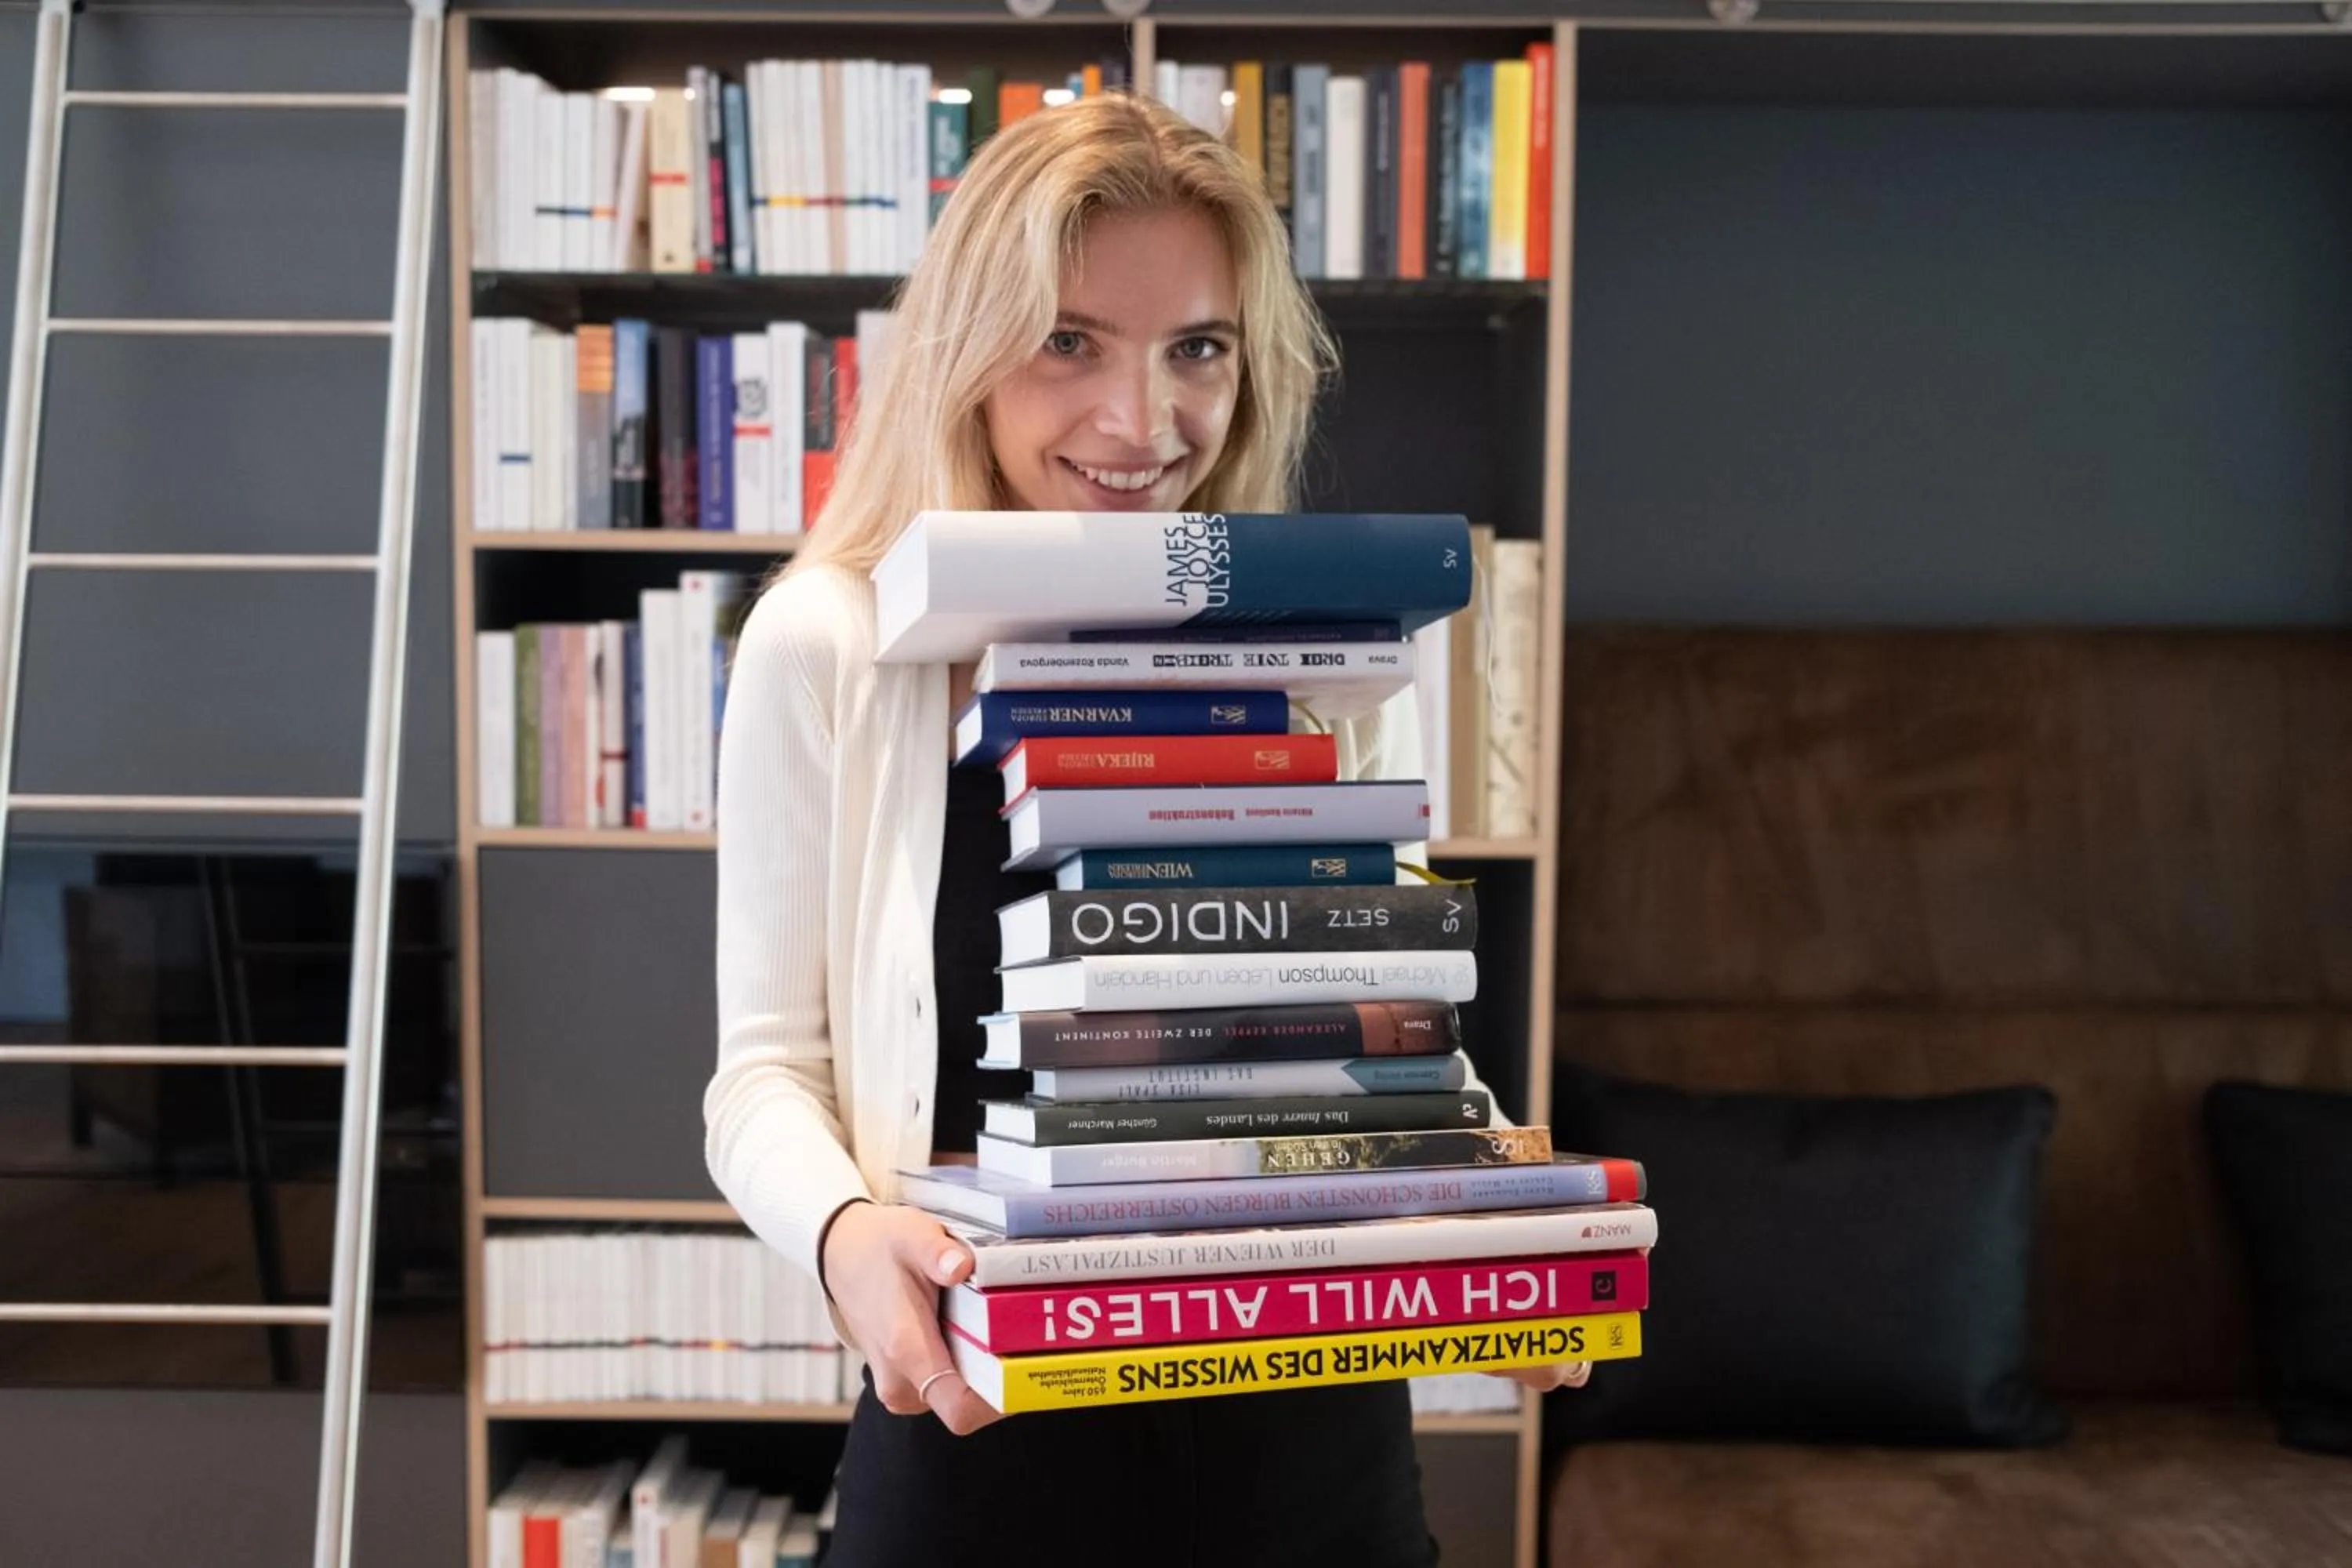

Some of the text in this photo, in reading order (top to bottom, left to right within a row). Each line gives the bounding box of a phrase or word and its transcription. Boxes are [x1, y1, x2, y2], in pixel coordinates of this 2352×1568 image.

[1183, 514, 1210, 588] JOYCE
[1164, 526, 1187, 607] JAMES
[1205, 514, 1230, 608] ULYSSES
[1097, 658, 1129, 667] Vanda
[1243, 654, 1289, 667] TOTE
[1300, 653, 1345, 666] DREI
[1368, 655, 1397, 665] Drava
[1048, 707, 1132, 723] KVARNER
[1097, 753, 1155, 769] RIJEKA
[1149, 809, 1234, 822] Rekonstruktion
[1146, 862, 1192, 877] WIEN
[1071, 901, 1288, 945] INDIGO
[1327, 909, 1389, 927] SETZ
[1443, 898, 1462, 934] SV
[1095, 967, 1272, 987] Leben und Handeln
[1279, 966, 1377, 985] Thompson
[1382, 967, 1446, 985] Michael
[1272, 1023, 1345, 1035] ALEXANDER
[1403, 1020, 1431, 1032] Drava
[1054, 1028, 1211, 1041] DER ZWEITE KONTINENT
[1069, 1116, 1157, 1131] Günther Marchner
[1207, 1111, 1348, 1127] Das Innere des Landes
[1152, 1154, 1197, 1169] Martin
[1267, 1150, 1350, 1168] GEHEN
[1044, 1180, 1461, 1225] DIE SCHÖNSTEN BURGEN ÖSTERREICHS
[1592, 1223, 1631, 1236] MANZ
[1021, 1238, 1335, 1272] DER WIENER JUSTIZPALAST
[1040, 1268, 1558, 1341] ICH WILL ALLES!
[1118, 1326, 1584, 1392] SCHATZKAMMER DES WISSENS
[1062, 1385, 1106, 1399] 650 Jahre
